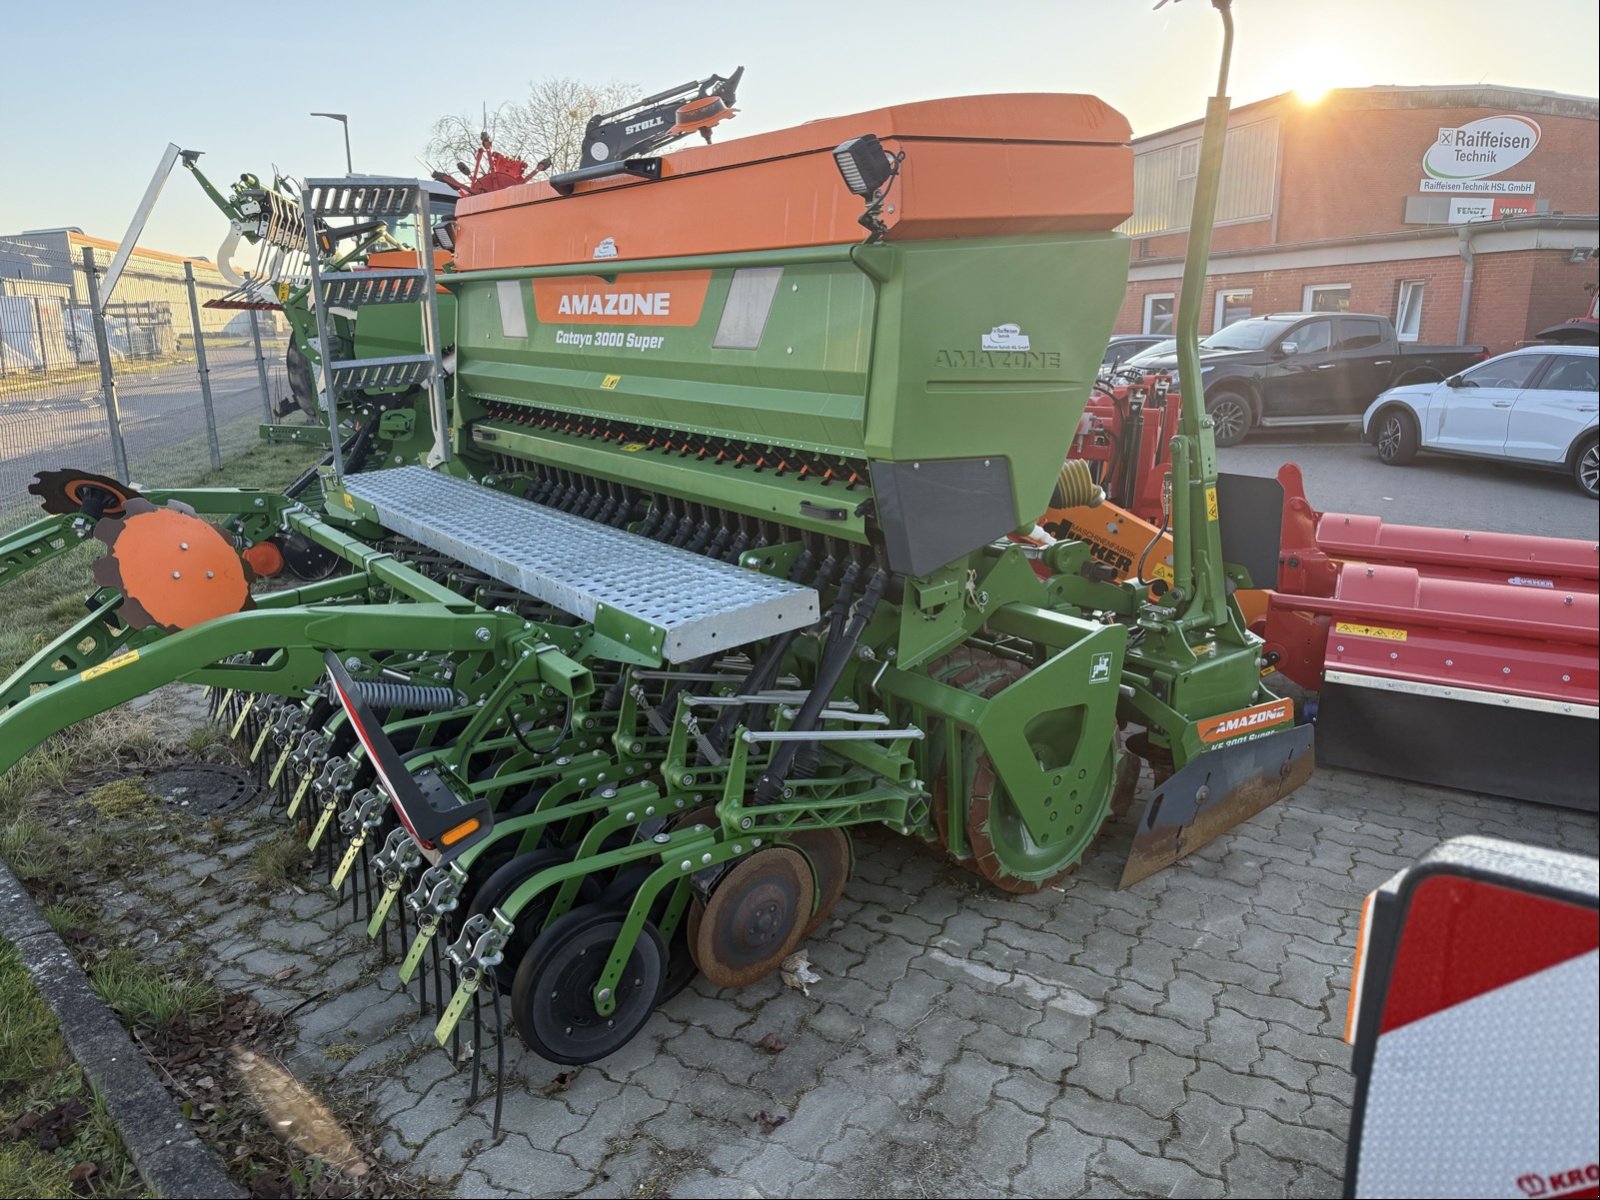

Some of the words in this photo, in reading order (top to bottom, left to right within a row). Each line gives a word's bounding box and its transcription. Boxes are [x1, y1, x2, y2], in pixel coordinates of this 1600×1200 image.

[625, 116, 664, 135] STOLL
[1455, 130, 1530, 149] Raiffeisen
[1455, 149, 1497, 162] Technik
[1424, 181, 1461, 191] Raiffeisen
[1462, 182, 1489, 191] Technik
[1490, 183, 1506, 191] HSL
[1507, 183, 1532, 192] GmbH
[1456, 207, 1486, 215] FENDT
[558, 293, 670, 315] AMAZONE
[556, 330, 592, 348] Cataya
[594, 332, 624, 348] 3000
[626, 333, 664, 352] Super
[934, 350, 1061, 368] AMAZONE
[1071, 524, 1137, 559] MASCHINENFABRIK
[1215, 706, 1286, 734] AMAZONE
